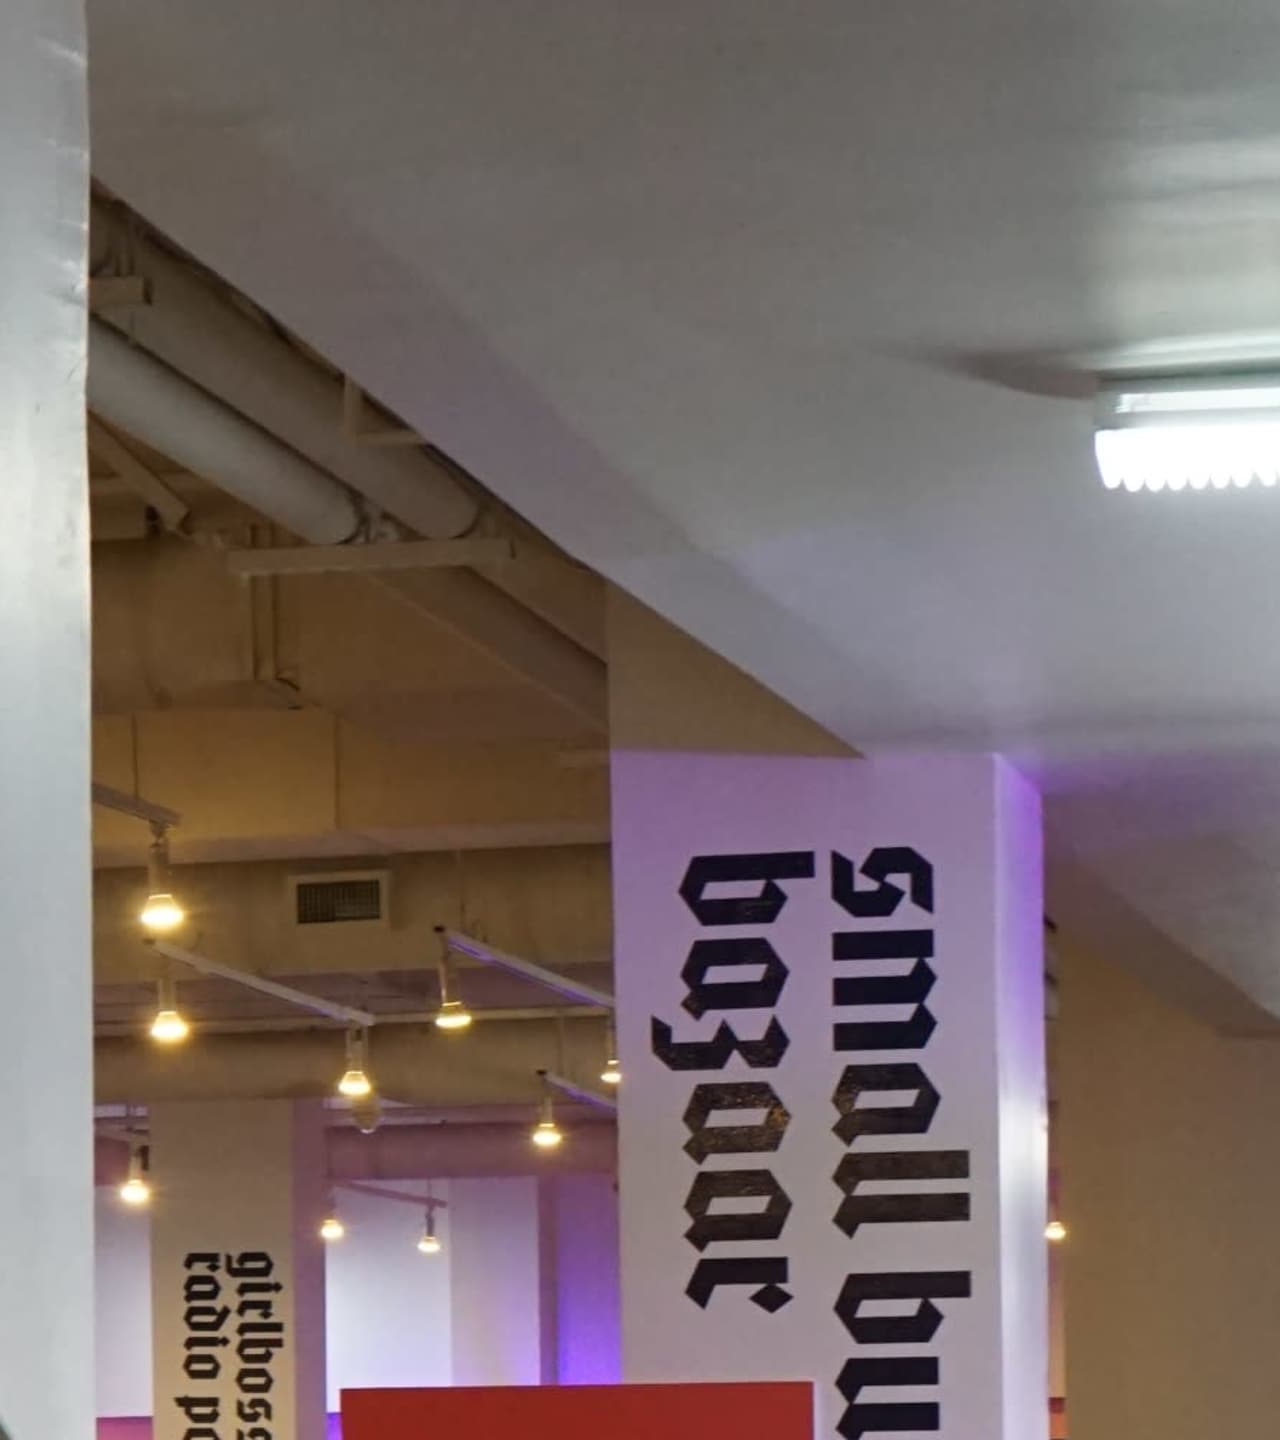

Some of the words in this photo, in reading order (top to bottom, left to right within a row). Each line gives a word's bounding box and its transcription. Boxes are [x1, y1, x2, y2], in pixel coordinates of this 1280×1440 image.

[651, 850, 815, 1314] bazaar
[830, 846, 970, 1239] small
[182, 1252, 231, 1380] radio
